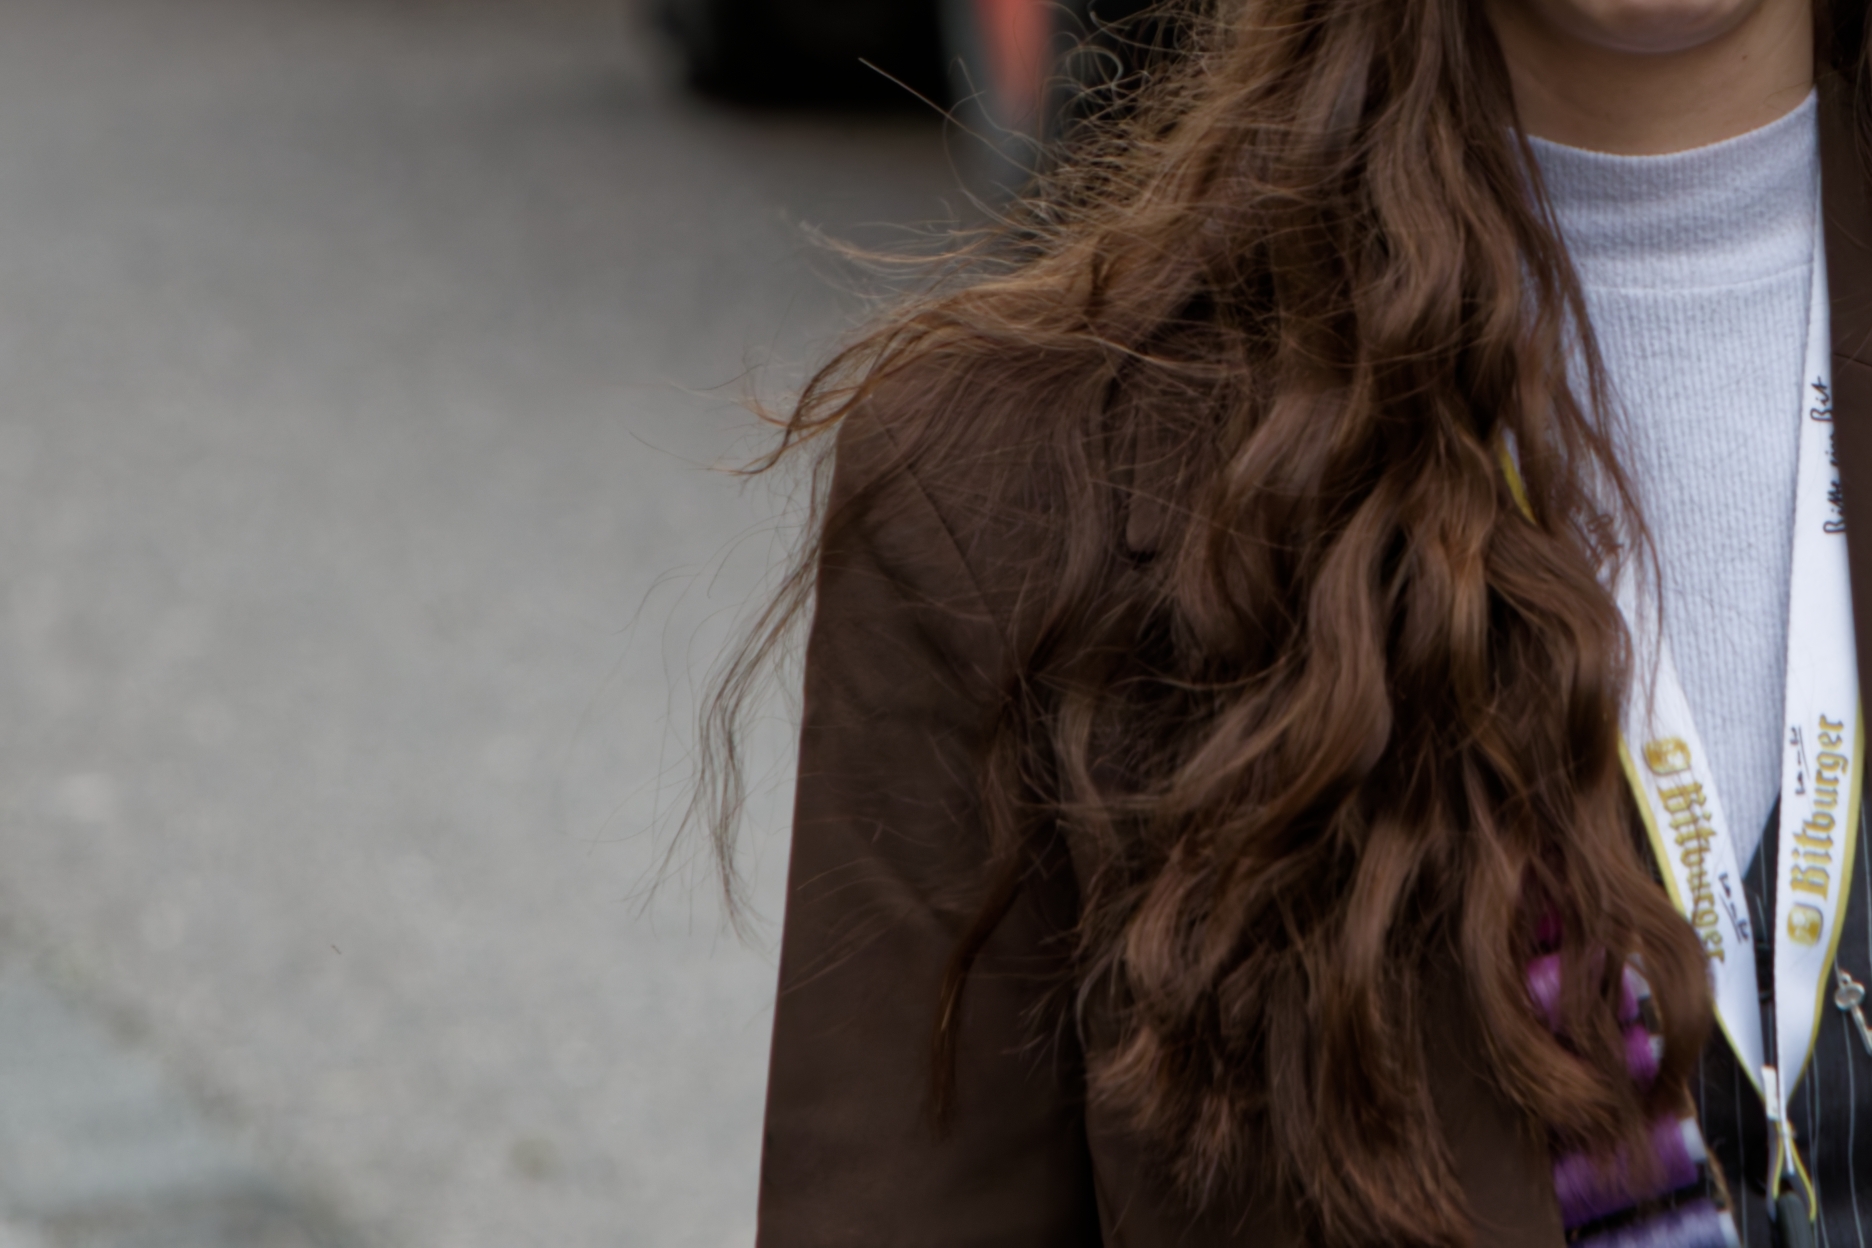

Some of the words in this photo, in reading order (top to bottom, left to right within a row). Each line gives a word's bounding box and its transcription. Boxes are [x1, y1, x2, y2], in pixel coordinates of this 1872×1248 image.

[1809, 375, 1834, 422] Bit
[1656, 780, 1726, 965] Bitburger
[1790, 713, 1849, 901] Bitburger
